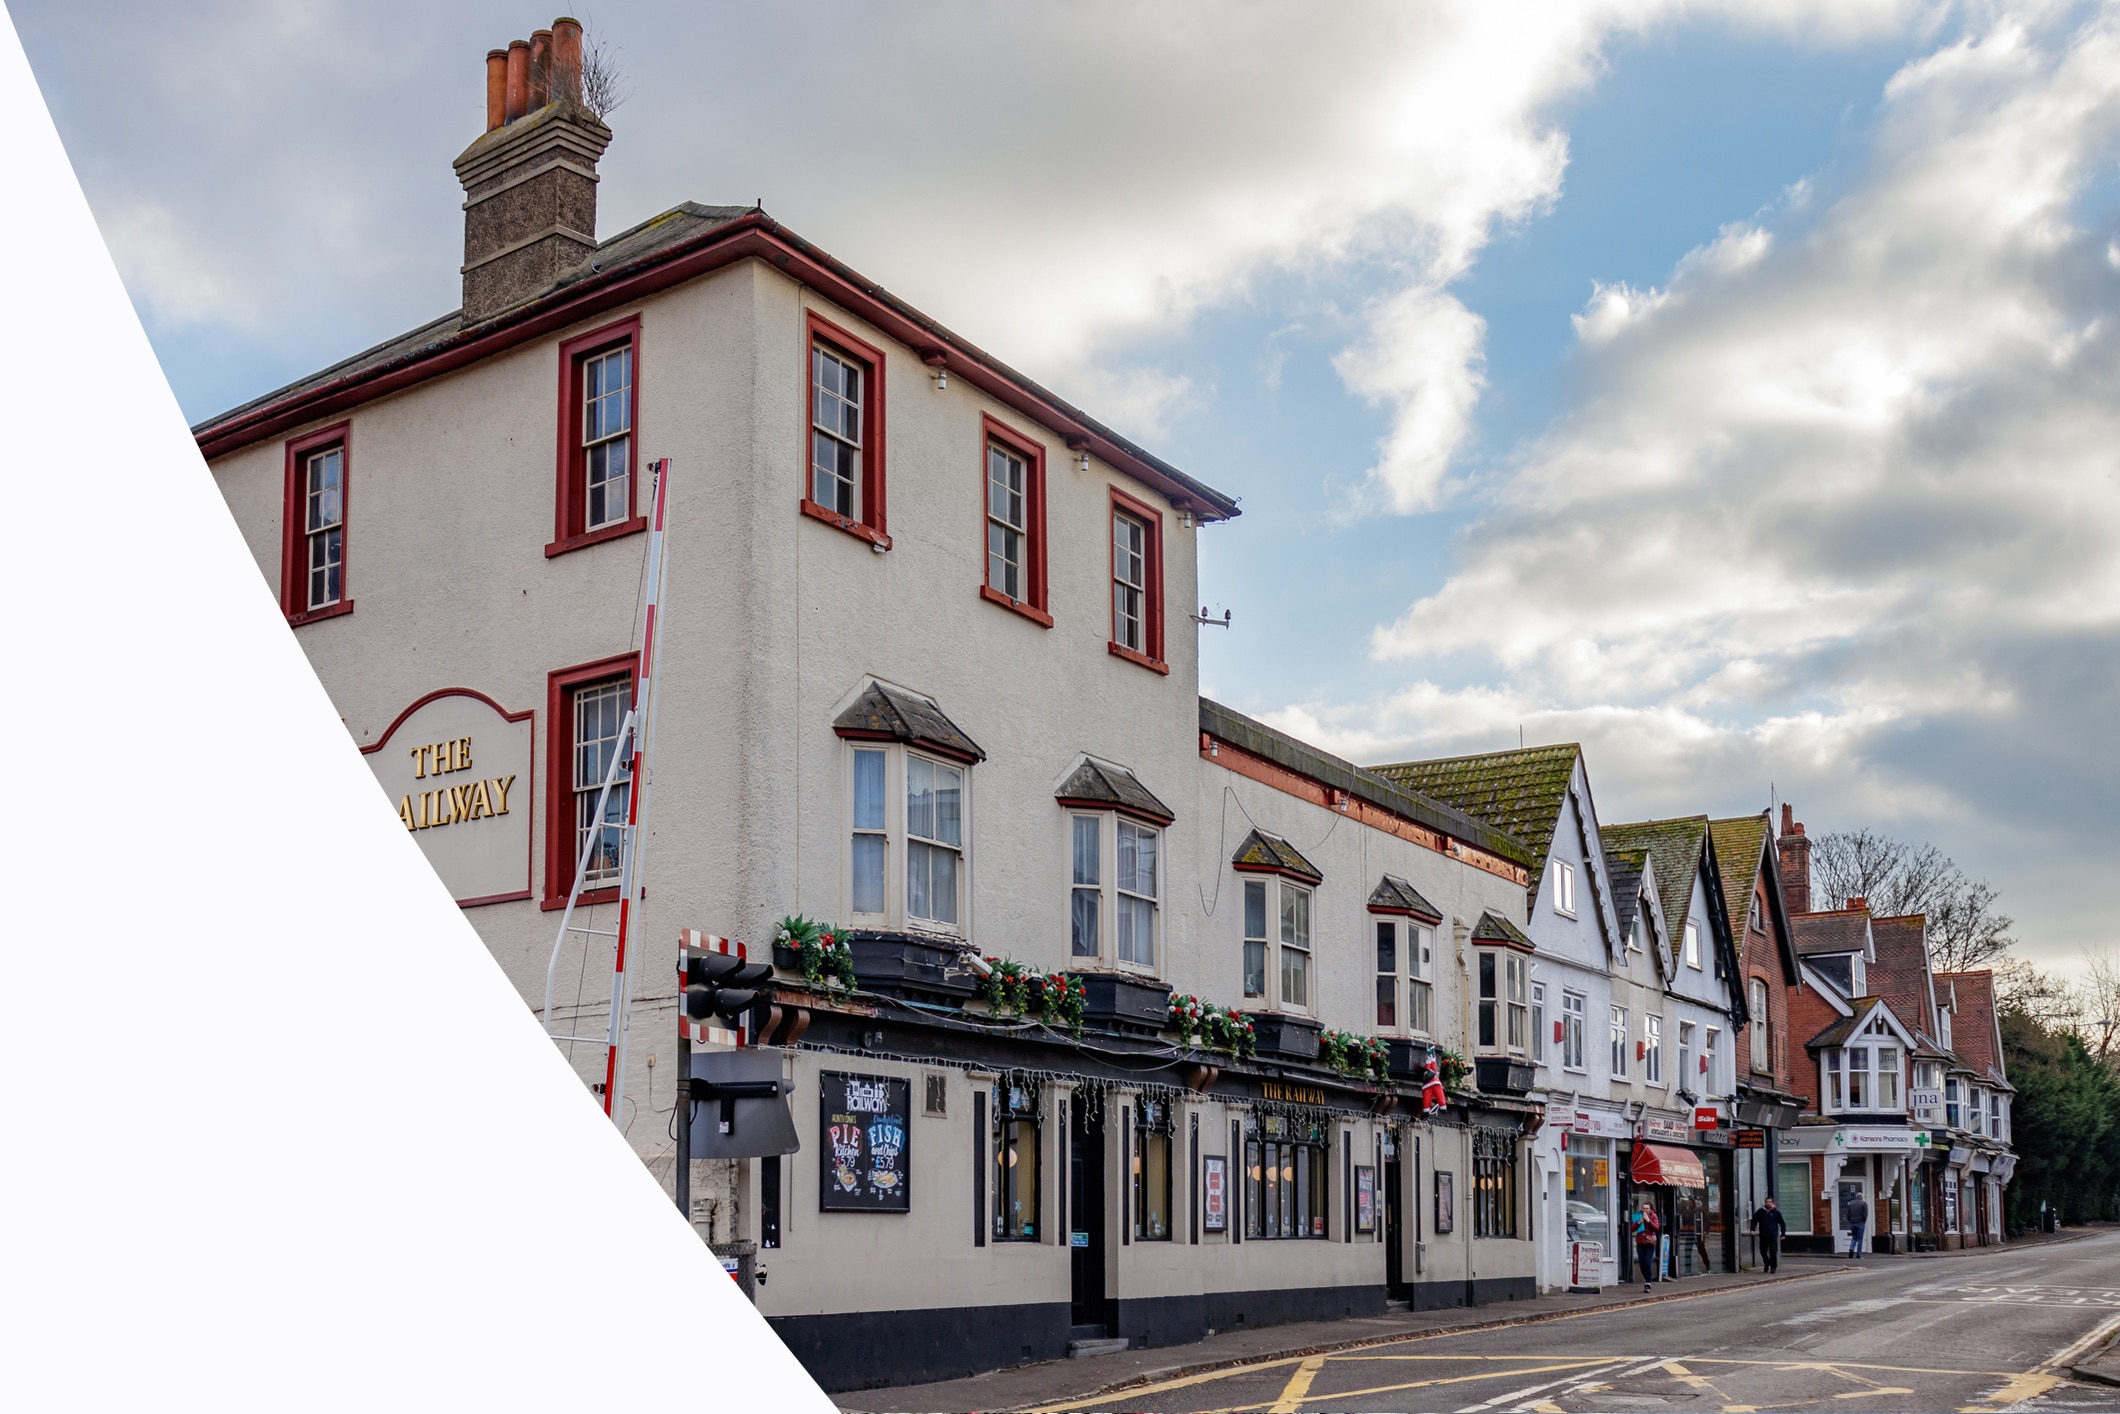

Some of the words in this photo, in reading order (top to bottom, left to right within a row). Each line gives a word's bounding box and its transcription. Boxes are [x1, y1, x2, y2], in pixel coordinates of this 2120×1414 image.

[410, 737, 473, 779] THE
[1262, 1081, 1283, 1100] THE
[1285, 1085, 1325, 1105] RAILWAY
[1910, 1089, 1938, 1109] jna
[829, 1124, 861, 1148] PIE
[868, 1124, 903, 1147] FISH
[834, 1144, 861, 1157] Kitchen
